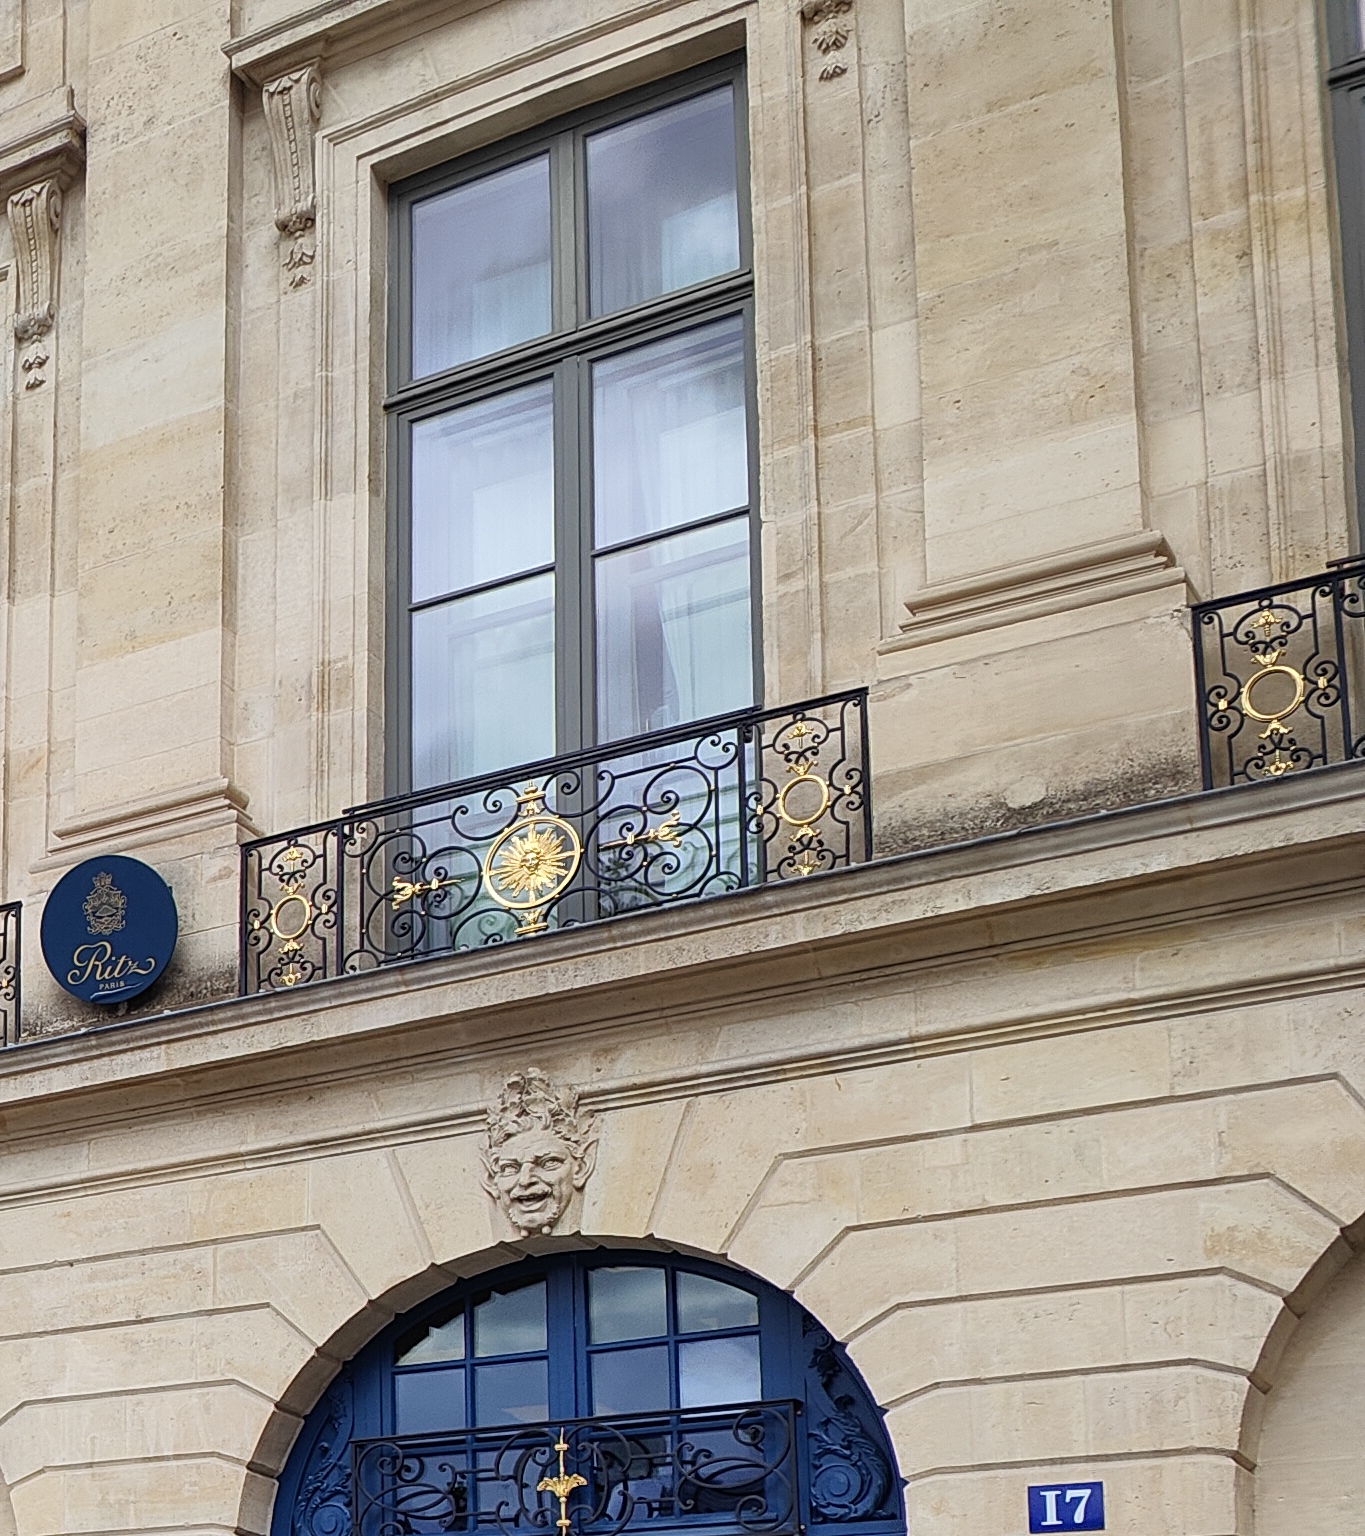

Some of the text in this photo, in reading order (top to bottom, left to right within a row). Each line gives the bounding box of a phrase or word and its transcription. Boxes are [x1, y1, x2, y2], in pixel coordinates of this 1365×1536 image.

[67, 941, 156, 985] Ritz
[99, 981, 125, 990] PARIS
[1040, 1489, 1091, 1525] 17
